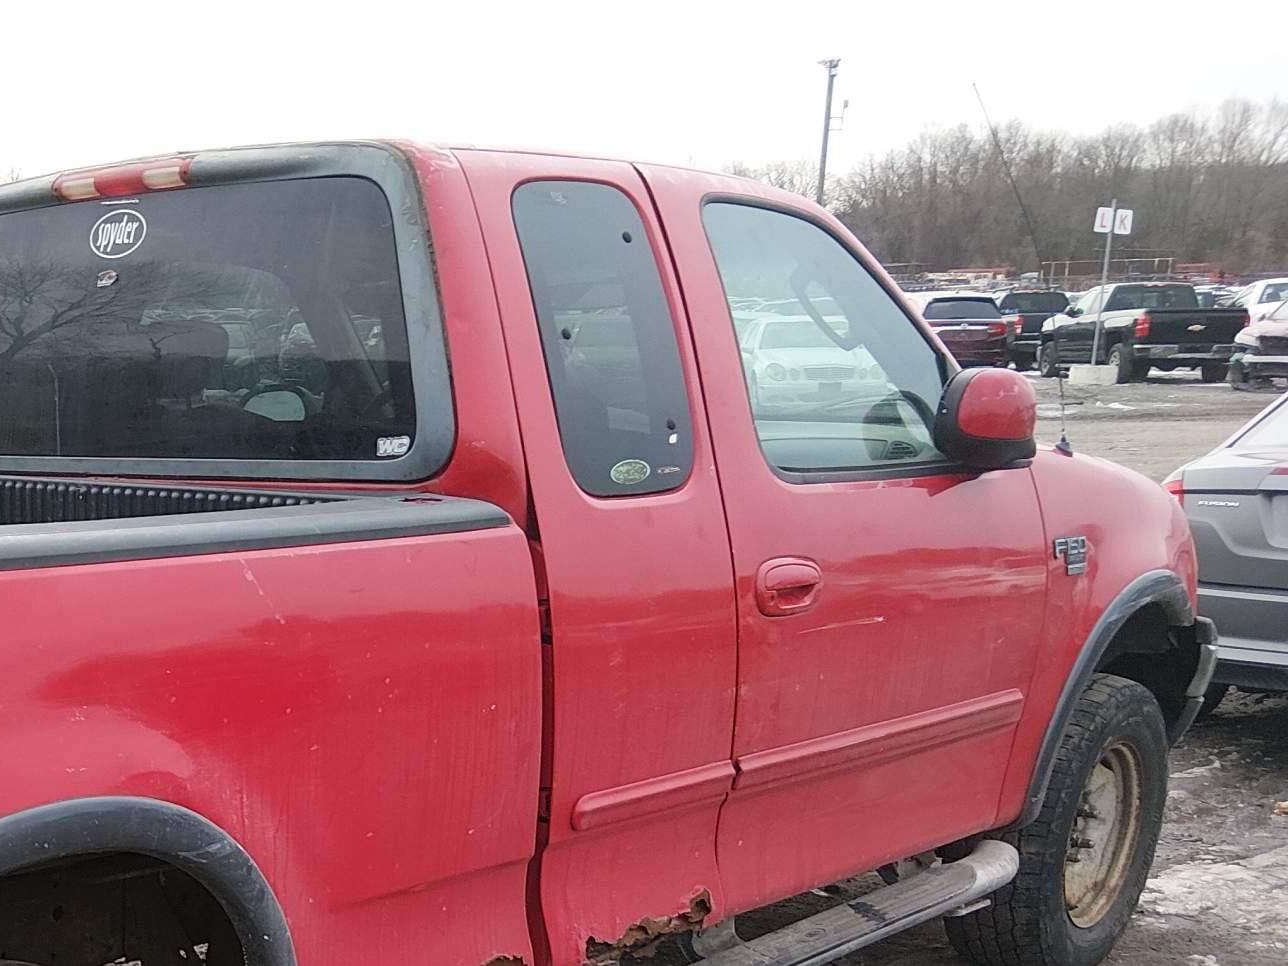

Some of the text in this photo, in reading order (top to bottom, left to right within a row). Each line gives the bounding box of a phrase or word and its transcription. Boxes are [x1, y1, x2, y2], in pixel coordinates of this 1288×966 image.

[1099, 211, 1107, 228] L
[1118, 213, 1129, 231] K
[96, 214, 140, 253] spyder
